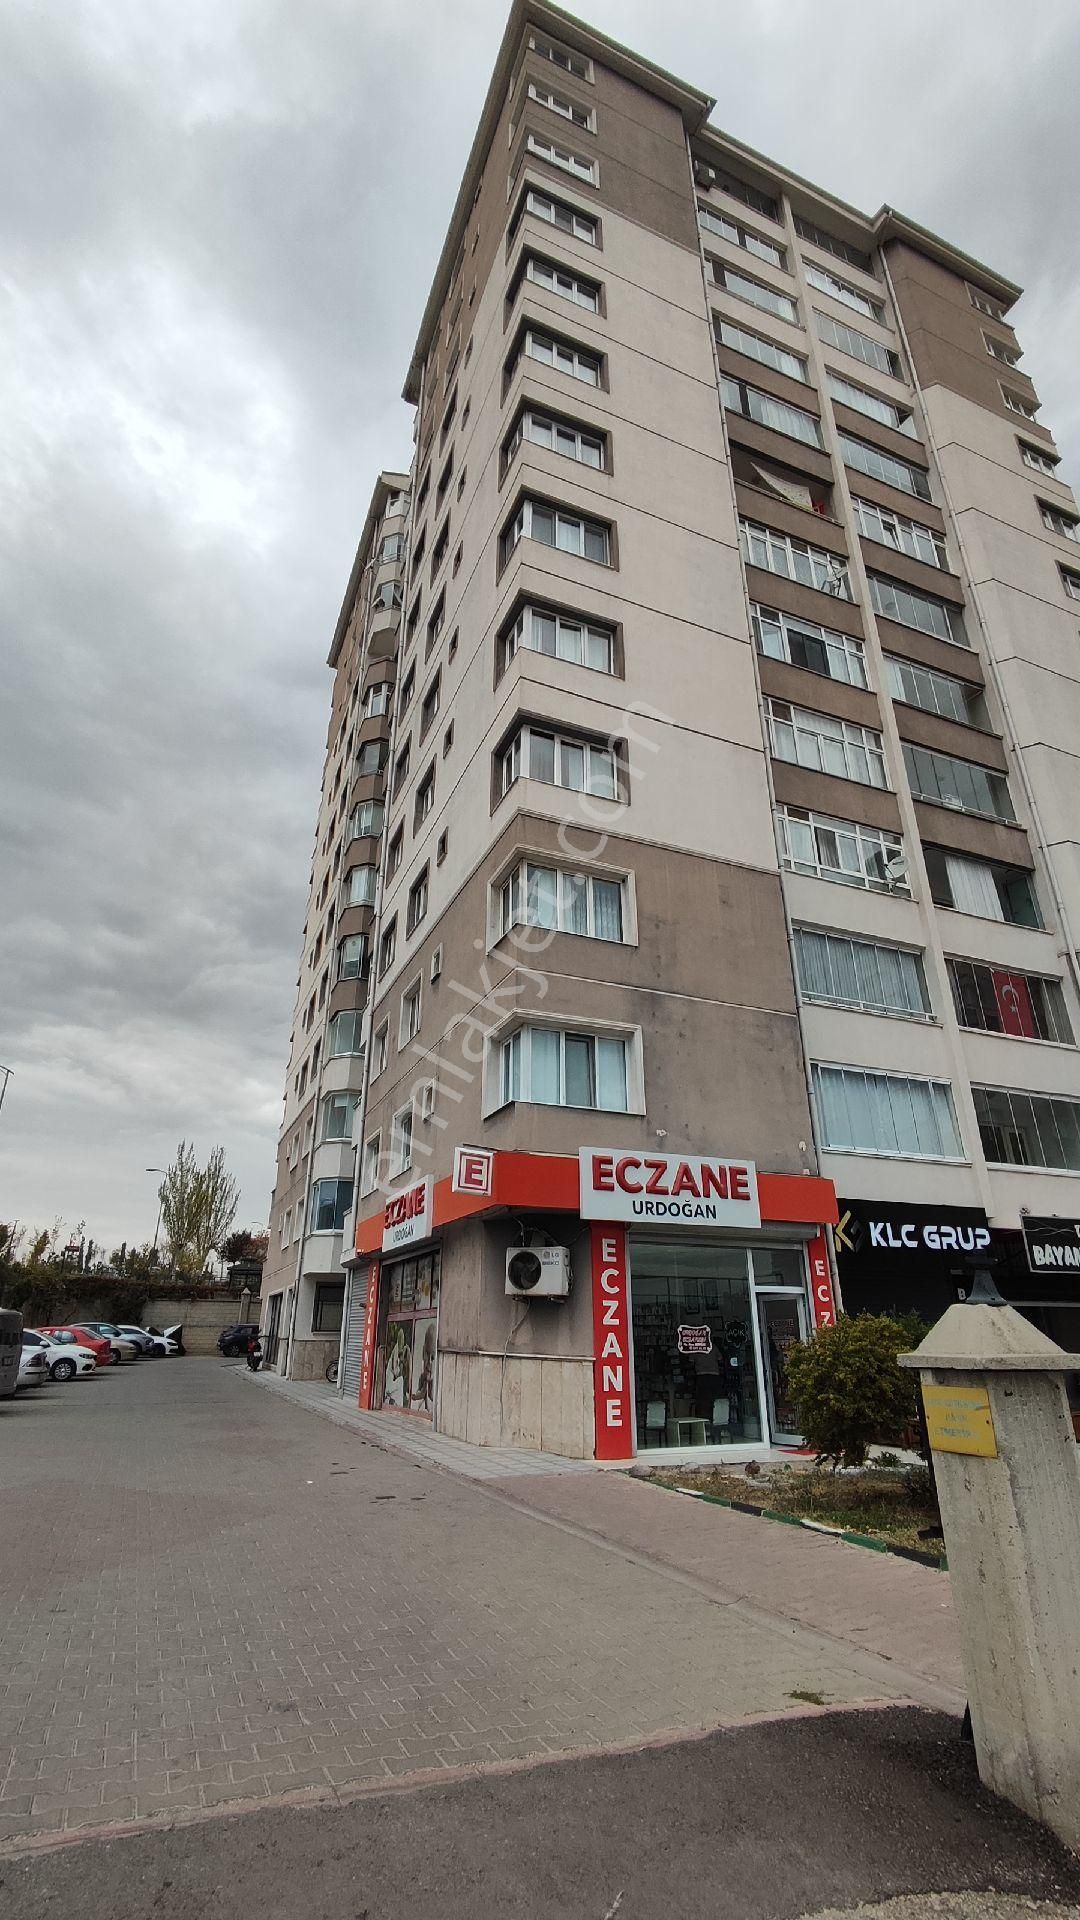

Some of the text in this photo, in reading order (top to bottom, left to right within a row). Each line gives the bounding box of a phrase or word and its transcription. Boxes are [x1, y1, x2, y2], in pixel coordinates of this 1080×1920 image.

[465, 1159, 483, 1186] E
[592, 1154, 751, 1201] ECZANE
[384, 1182, 426, 1230] ECZANE
[632, 1199, 717, 1220] URDOĞAN
[868, 1221, 991, 1251] KLC GRUP
[814, 1260, 832, 1328] ECZ
[362, 1266, 377, 1390] ECZANE
[600, 1238, 623, 1427] ECZANE
